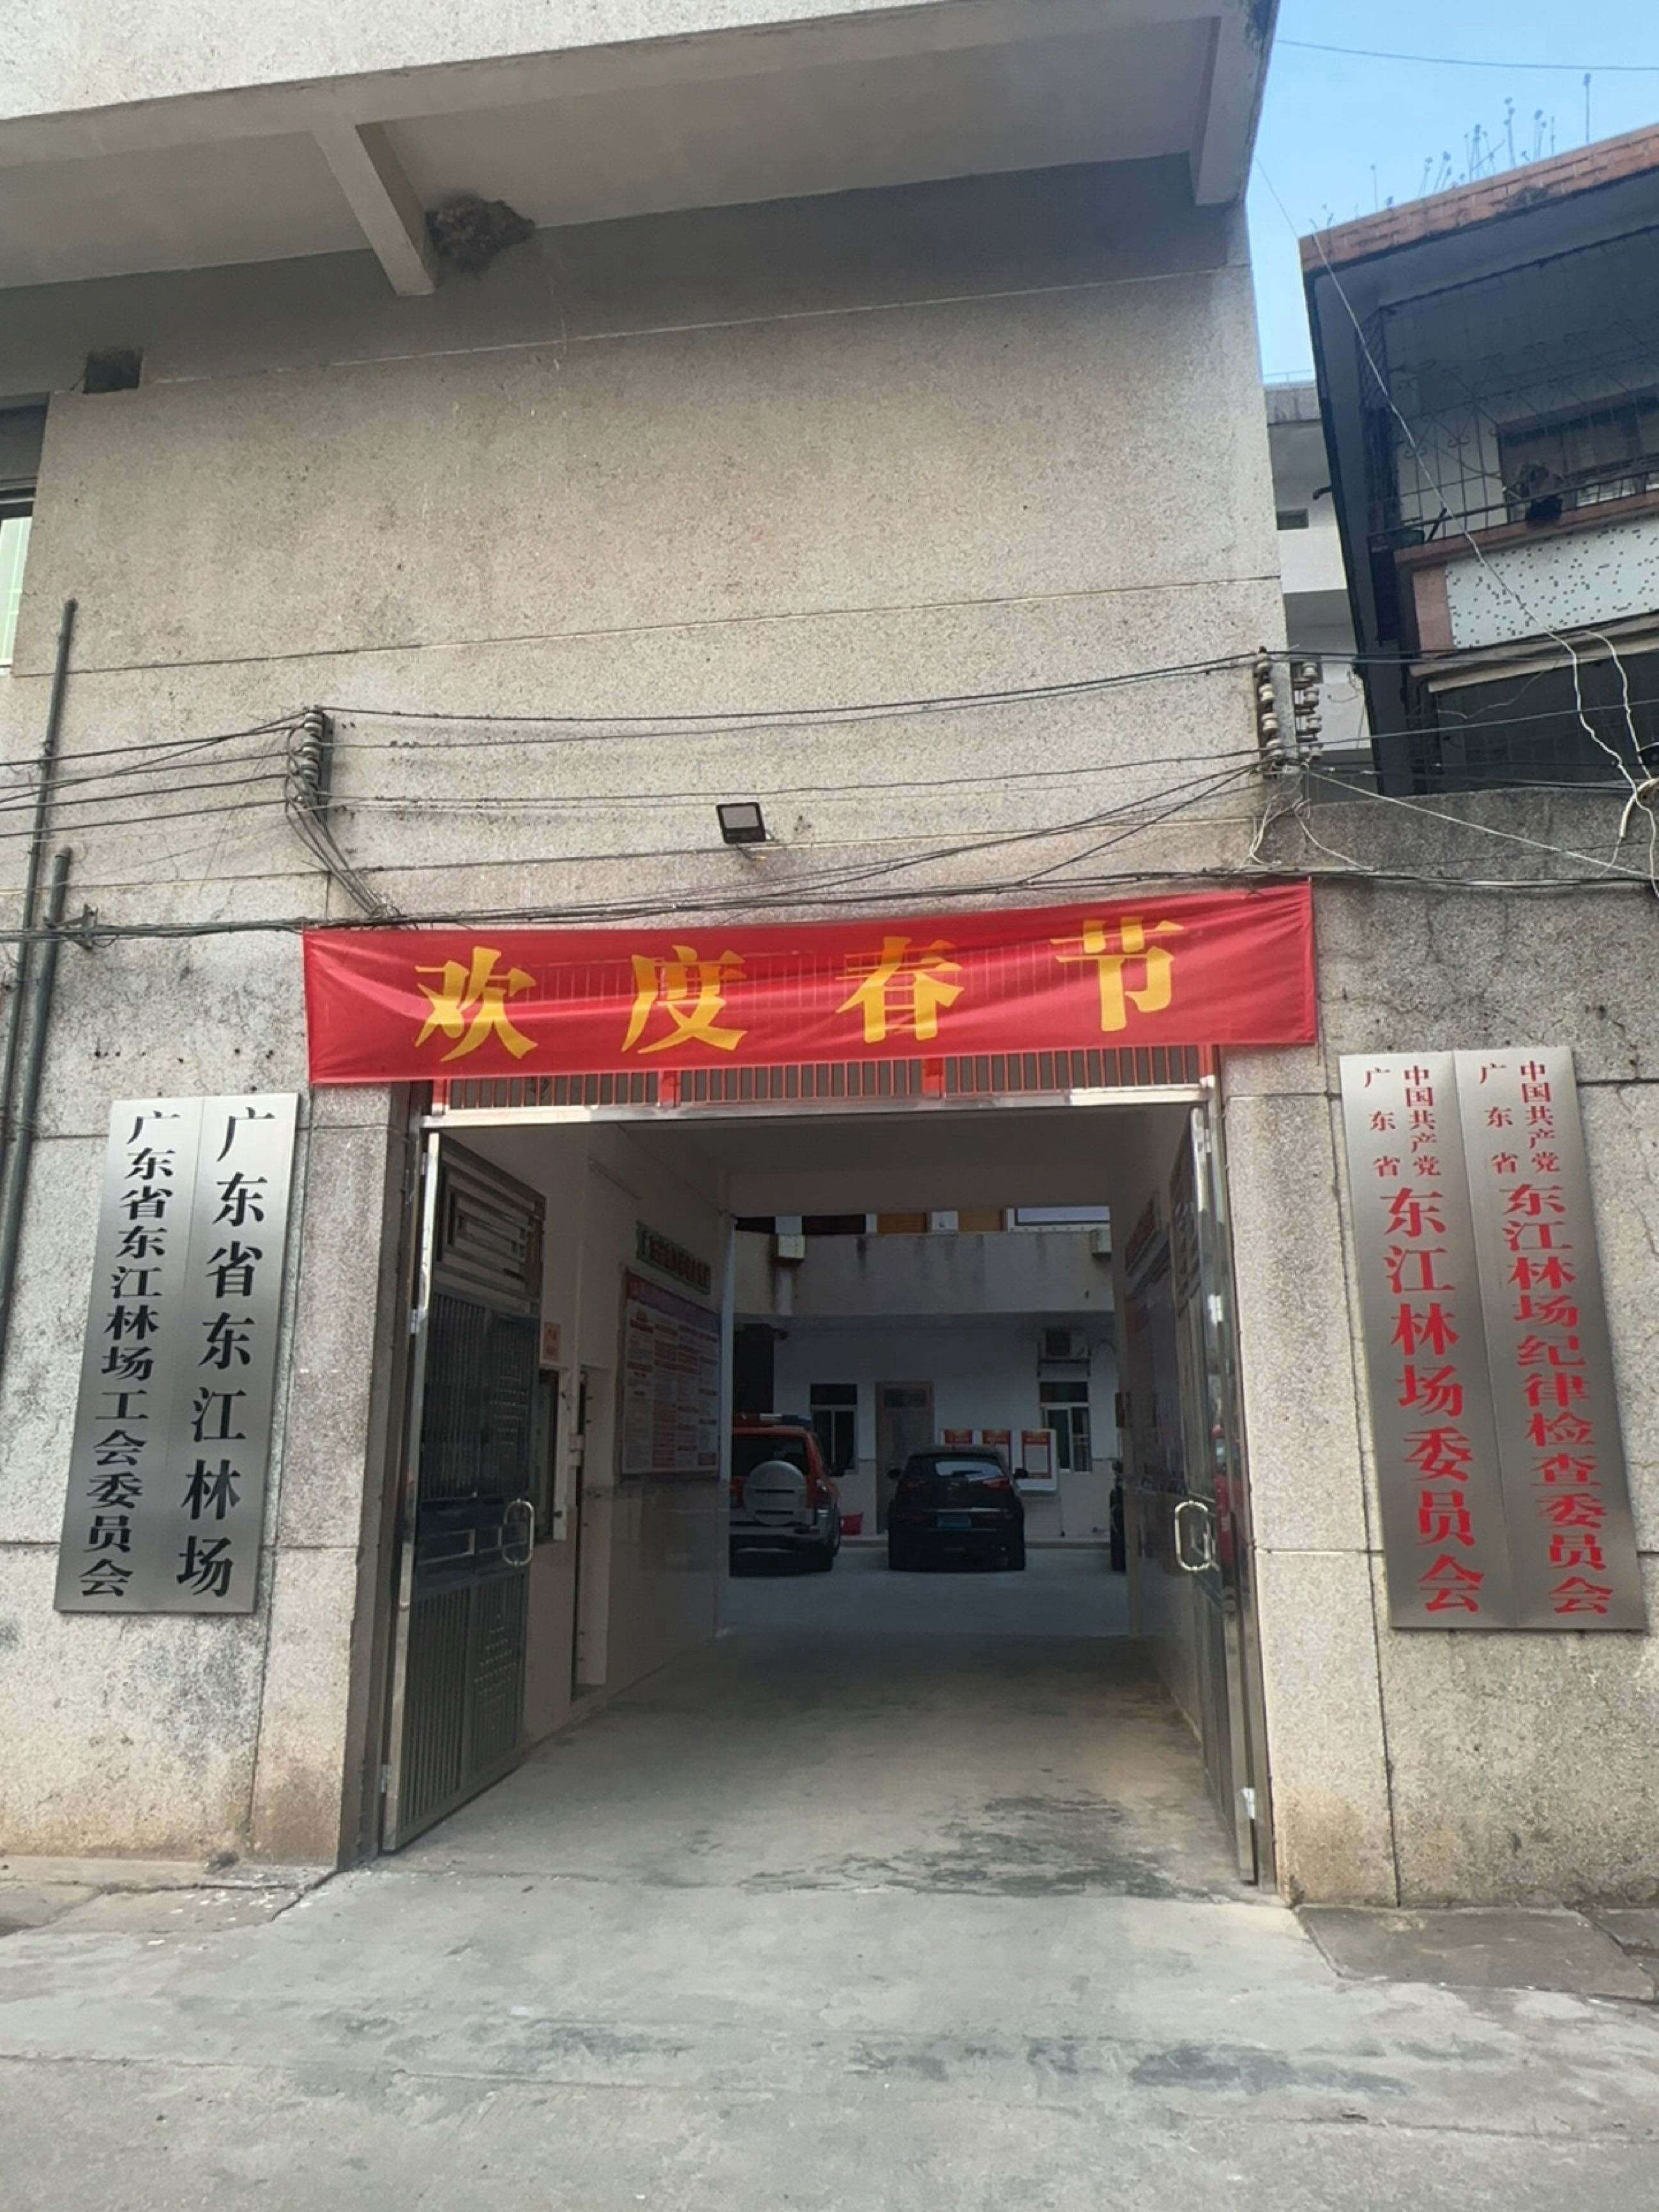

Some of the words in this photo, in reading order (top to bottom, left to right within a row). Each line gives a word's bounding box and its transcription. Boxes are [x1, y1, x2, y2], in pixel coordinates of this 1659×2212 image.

[414, 916, 1184, 1062] 欢度春节
[1364, 1067, 1400, 1178] 广东省
[1404, 1064, 1442, 1177] 中国共产党
[1479, 1062, 1519, 1175] 广东省
[1519, 1060, 1562, 1174] 中国共产党
[81, 1110, 180, 1598] 广东省东江林场工会委员会
[176, 1107, 276, 1598] 广东省东江林场
[1379, 1187, 1485, 1614] 东江林场委员会
[1502, 1183, 1614, 1615] 东江林场纪律检查委员会
